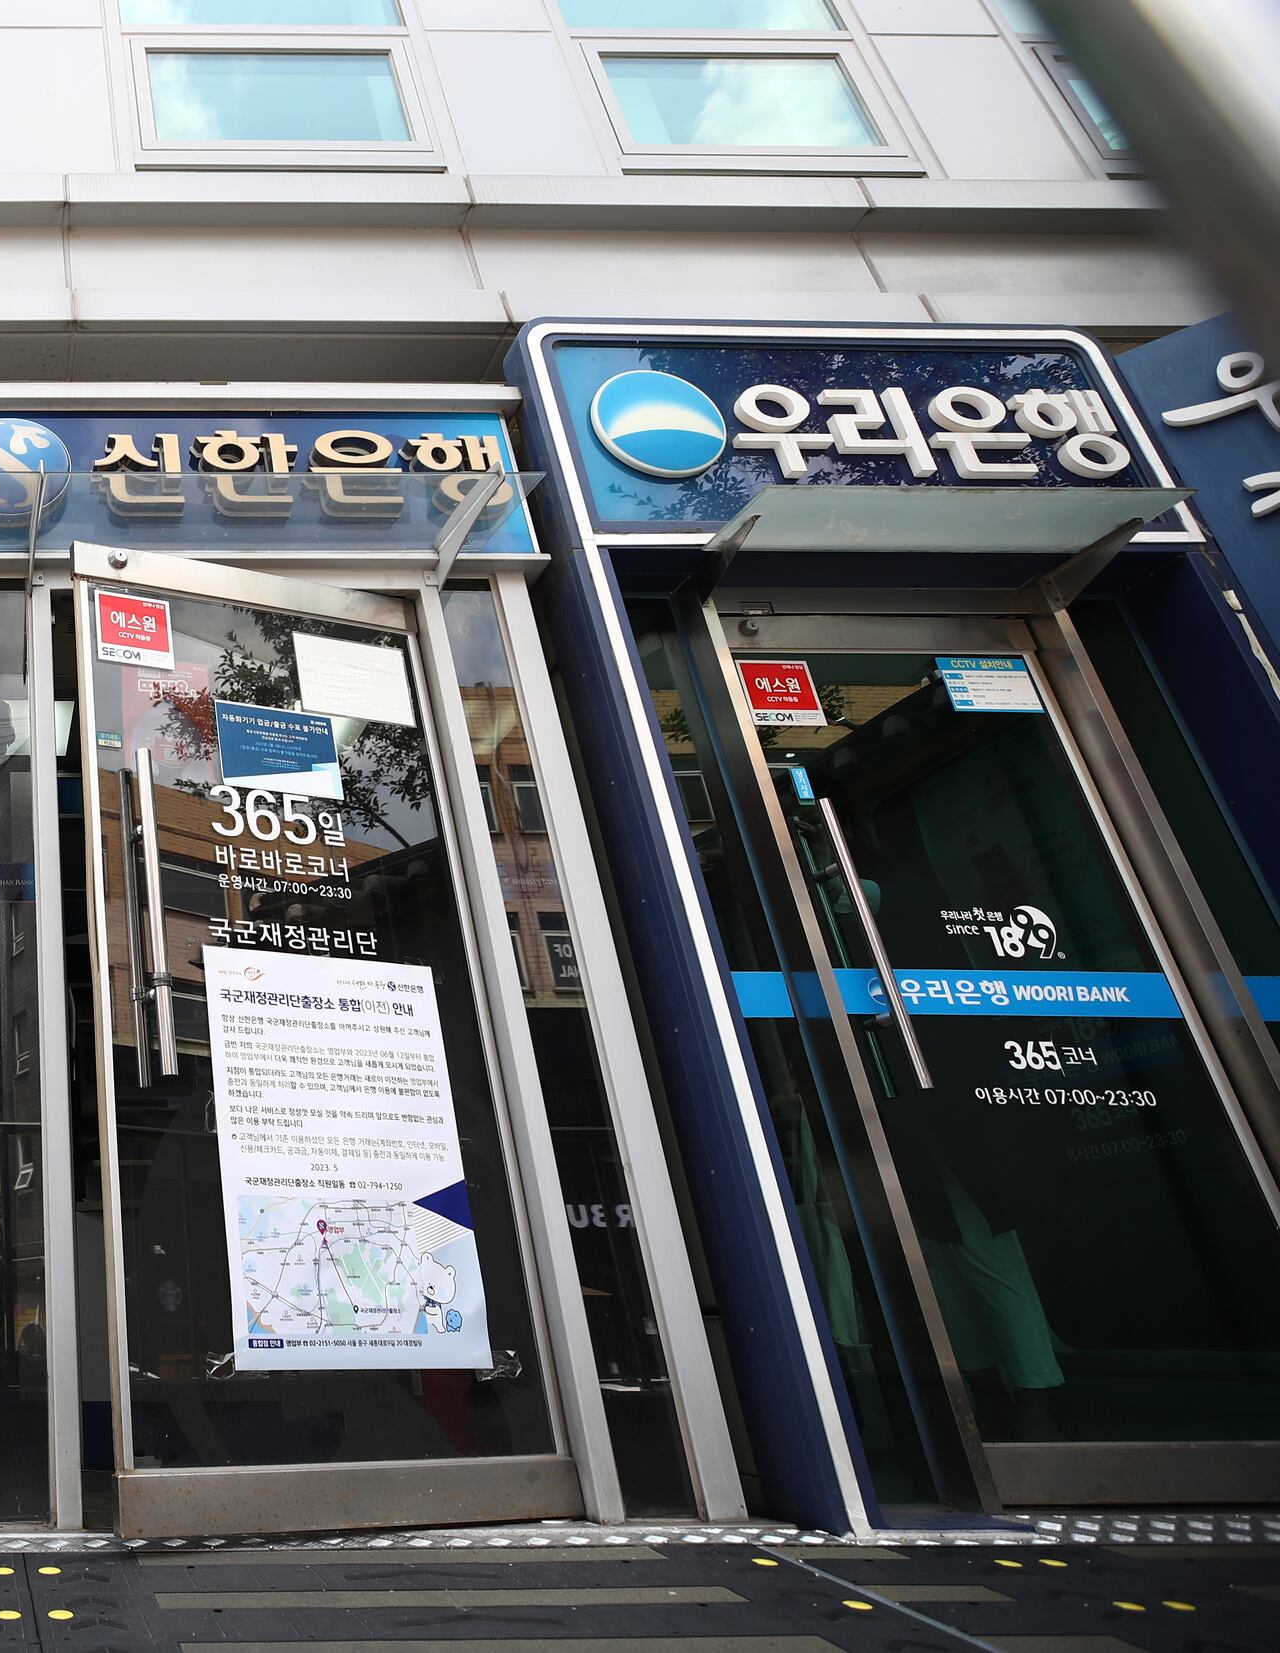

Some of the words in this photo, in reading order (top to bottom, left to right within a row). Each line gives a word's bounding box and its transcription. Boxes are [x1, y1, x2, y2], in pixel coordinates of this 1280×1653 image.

[733, 383, 1130, 480] 우리은행
[93, 430, 514, 518] 신한은행
[110, 610, 157, 633] 에스원
[118, 631, 135, 639] CCTV
[102, 646, 141, 660] SECOM
[950, 659, 976, 669] CCTV
[979, 659, 1014, 670] 설치안내
[754, 677, 802, 693] 에스원
[221, 713, 256, 725] 자동화기기
[256, 718, 287, 730] 입금/출금
[287, 723, 301, 731] 수표
[755, 712, 794, 722] SECOM
[209, 784, 346, 847] 365일
[215, 844, 350, 883] 바로바로코너
[218, 873, 268, 892] 운영시간
[273, 880, 352, 900] 07:00~23:30
[940, 909, 973, 921] 우리나라
[972, 907, 986, 921] 첫
[986, 911, 1004, 922] 은행
[208, 917, 378, 956] 국군재정관리단
[945, 924, 980, 935] since
[983, 905, 1057, 959] 1899
[397, 983, 424, 994] 신한은행
[900, 979, 1010, 1006] 우리은행
[1012, 984, 1074, 1002] WOORI
[1077, 985, 1131, 1003] BANK
[219, 989, 336, 1011] 국군재정관리단출장소
[338, 997, 391, 1016] 통합(이전)
[392, 1002, 414, 1017] 안내
[221, 1013, 235, 1024] 항상
[237, 1015, 264, 1025] 신한은행
[266, 1016, 336, 1031] 국군재정관리단출장소를
[373, 1024, 392, 1034] 성원해
[393, 1026, 406, 1036] 주신
[222, 1024, 236, 1035] 감사
[237, 1025, 266, 1036] 드립니다.
[224, 1039, 238, 1050] 금번
[239, 1040, 253, 1050] 저희
[255, 1041, 325, 1056] 국군재정관리단출장소는
[327, 1046, 353, 1057] 영업부와
[355, 1048, 378, 1058] 2023년
[379, 1049, 395, 1059] 06월
[397, 1051, 422, 1061] 12일부터
[423, 1053, 435, 1063] 통합
[224, 1050, 238, 1060] 하여
[240, 1051, 272, 1062] 영업부에서
[274, 1053, 288, 1063] 더욱
[310, 1056, 335, 1066] 환경으로
[337, 1058, 363, 1068] 고객님을
[385, 1061, 404, 1070] 모시게
[1004, 1040, 1063, 1071] 365
[1061, 1046, 1098, 1066] 코너
[226, 1066, 247, 1076] 지점이
[248, 1067, 287, 1078] 통합되더라도
[289, 1069, 315, 1080] 고객님의
[316, 1071, 329, 1081] 모든
[331, 1072, 362, 1084] 은행거래는
[364, 1074, 383, 1085] 새로이
[385, 1076, 409, 1086] 이전하는
[410, 1077, 439, 1088] 영업부에서
[228, 1089, 265, 1099] 하겠습니다.
[974, 1086, 1041, 1106] 이용시간
[1044, 1088, 1158, 1107] 07:00~23:30
[229, 1104, 243, 1114] 보다
[244, 1105, 259, 1115] 나은
[260, 1106, 287, 1116] 서비스로
[310, 1109, 323, 1118] 모실
[325, 1109, 338, 1119] 것을
[339, 1110, 353, 1120] 약속
[354, 1111, 374, 1121] 드리며
[375, 1112, 400, 1122] 앞으로도
[426, 1115, 444, 1125] 관심과
[230, 1116, 244, 1126] 많은
[246, 1116, 259, 1126] 이용
[261, 1117, 275, 1127] 부탁
[276, 1118, 304, 1128] 드립니다.
[310, 1163, 332, 1172] 2023.
[333, 1163, 339, 1172] 5
[244, 1176, 316, 1188] 국군재정관리단출장소
[317, 1179, 345, 1189] 직원일동
[357, 1181, 403, 1191] 02-794-1250
[285, 1339, 302, 1347] 영업부
[309, 1339, 346, 1347] 02-2151-5050
[347, 1340, 357, 1348] 서울
[357, 1340, 368, 1348] 중구
